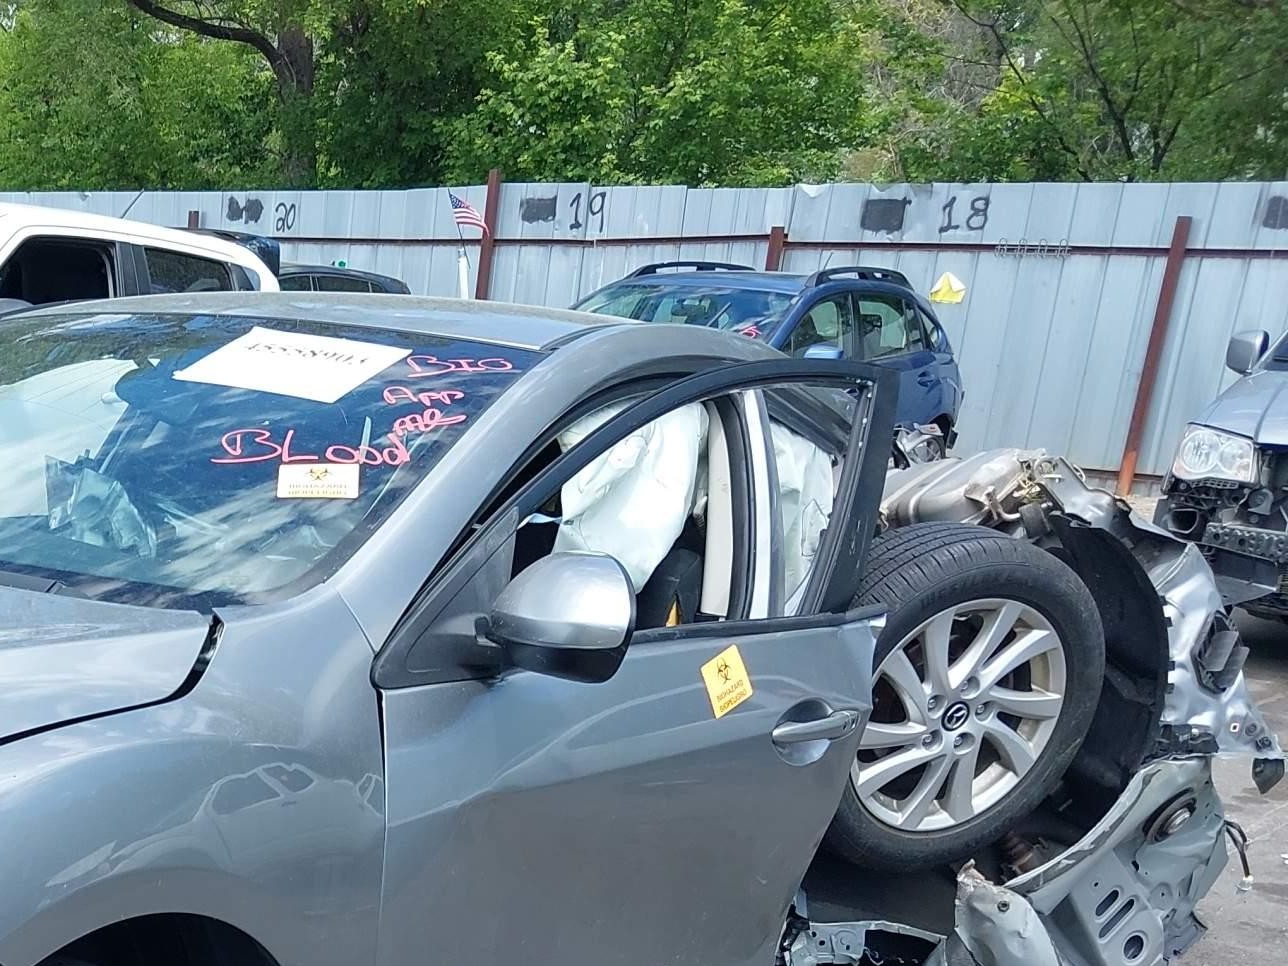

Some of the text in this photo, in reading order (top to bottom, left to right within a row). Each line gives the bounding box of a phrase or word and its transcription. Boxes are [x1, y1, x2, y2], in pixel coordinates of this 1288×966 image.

[275, 202, 296, 233] 20
[569, 191, 607, 233] 19
[938, 195, 991, 234] 18
